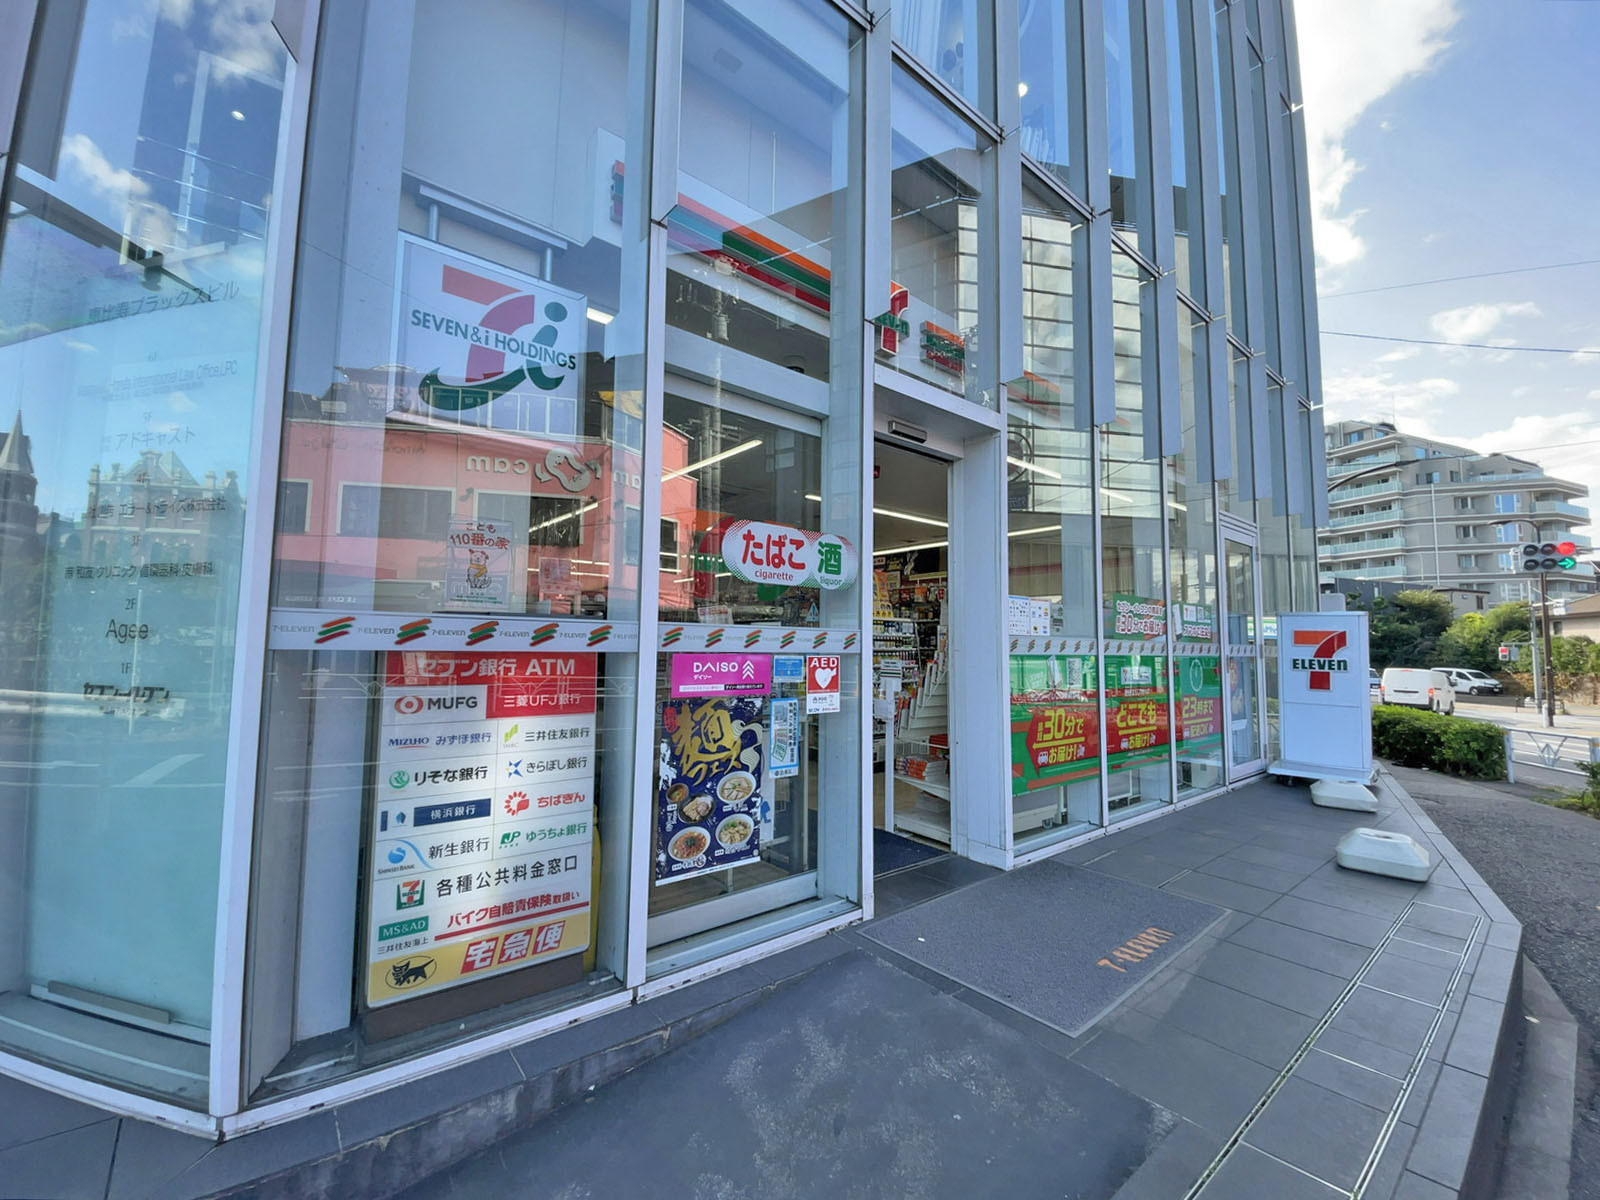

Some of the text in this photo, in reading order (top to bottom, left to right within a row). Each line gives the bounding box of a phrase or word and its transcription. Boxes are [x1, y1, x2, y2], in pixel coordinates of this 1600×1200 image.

[495, 333, 576, 370] HOLDINGS
[450, 533, 510, 550] 110番の家
[742, 529, 842, 575] たばこ 酒
[755, 569, 843, 587] cigarette liquor
[125, 598, 136, 610] 2F
[105, 618, 149, 643] Agee
[121, 662, 131, 674] 1F
[418, 658, 576, 678] セブン銀行 ATM
[693, 661, 739, 674] DAISO
[810, 657, 838, 668] AED
[427, 696, 478, 710] MUFG
[503, 693, 582, 708] 三菱UFJ銀行
[1117, 702, 1157, 728] どこでも
[388, 736, 430, 747] MIZUHO
[435, 732, 492, 746] みずほ銀行
[524, 727, 590, 743] 三井住友銀行
[1049, 744, 1078, 763] お届け!
[526, 757, 588, 774] きらぼし銀行
[414, 766, 488, 785] りそな銀行
[537, 791, 585, 808] ちばぎん
[431, 806, 476, 820] 横浜銀行
[526, 822, 588, 843] ゆうちょ銀行
[428, 837, 490, 860] 新生銀行
[436, 855, 578, 898] 各種公共料金窓口
[383, 919, 426, 938] MS&AD
[377, 936, 429, 955] 三井住友海上
[463, 921, 566, 973] 宅急便
